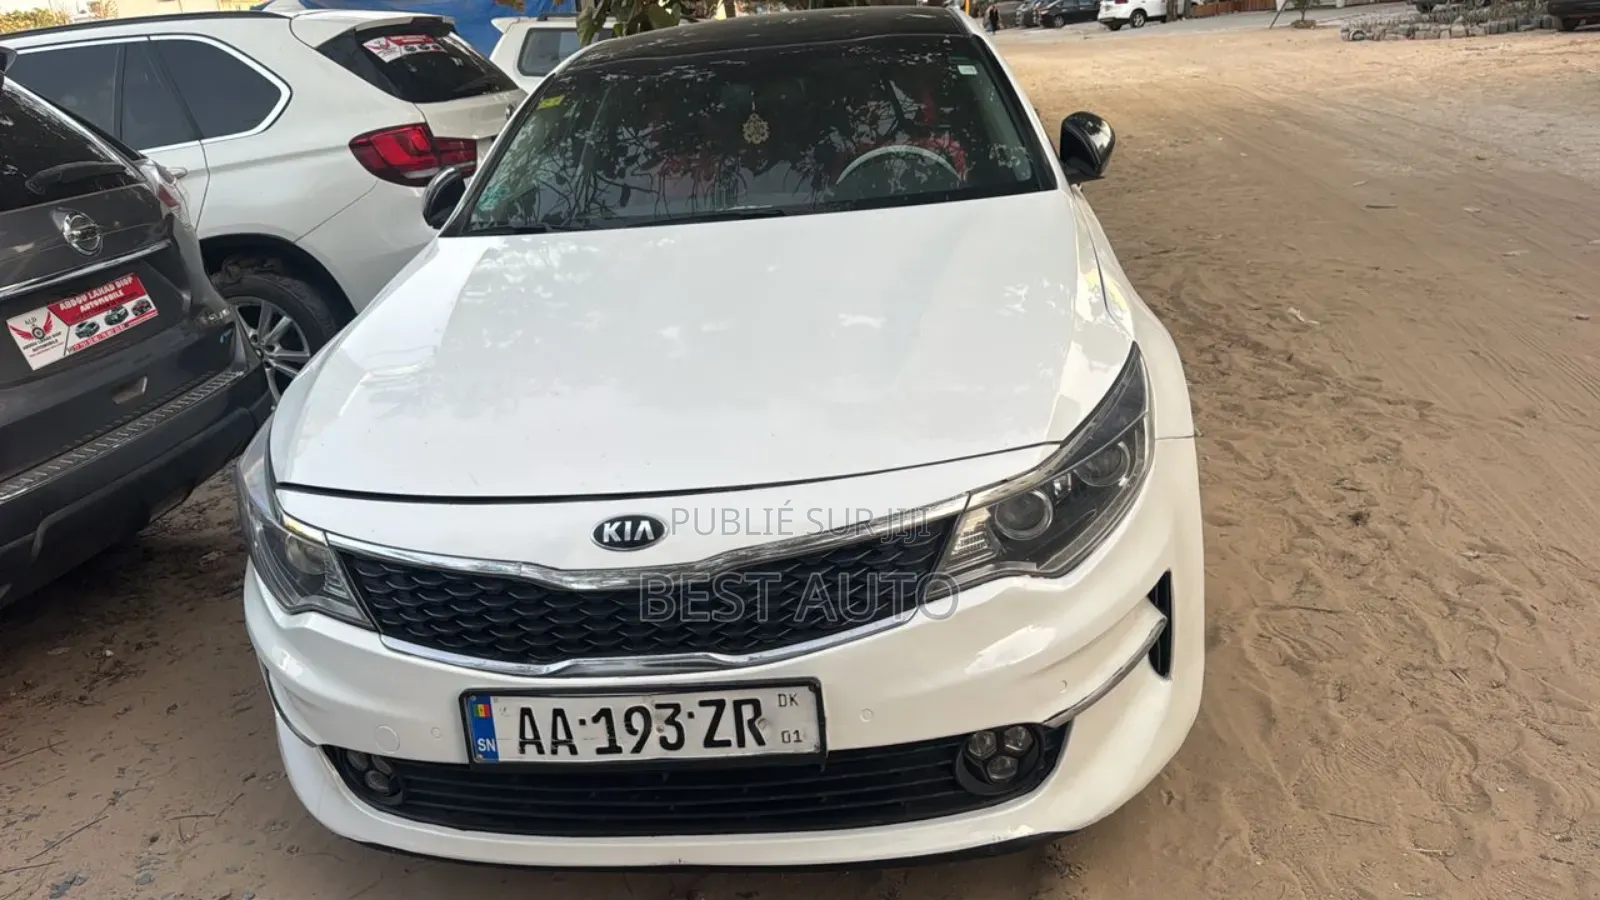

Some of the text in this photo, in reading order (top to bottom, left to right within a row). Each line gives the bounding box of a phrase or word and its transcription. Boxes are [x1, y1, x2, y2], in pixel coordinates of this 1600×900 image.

[88, 282, 115, 300] LAHAD
[80, 290, 125, 312] AUTOMOBILE
[603, 522, 655, 542] KIA
[778, 693, 799, 707] DK
[781, 729, 803, 744] 01
[477, 738, 496, 752] SN
